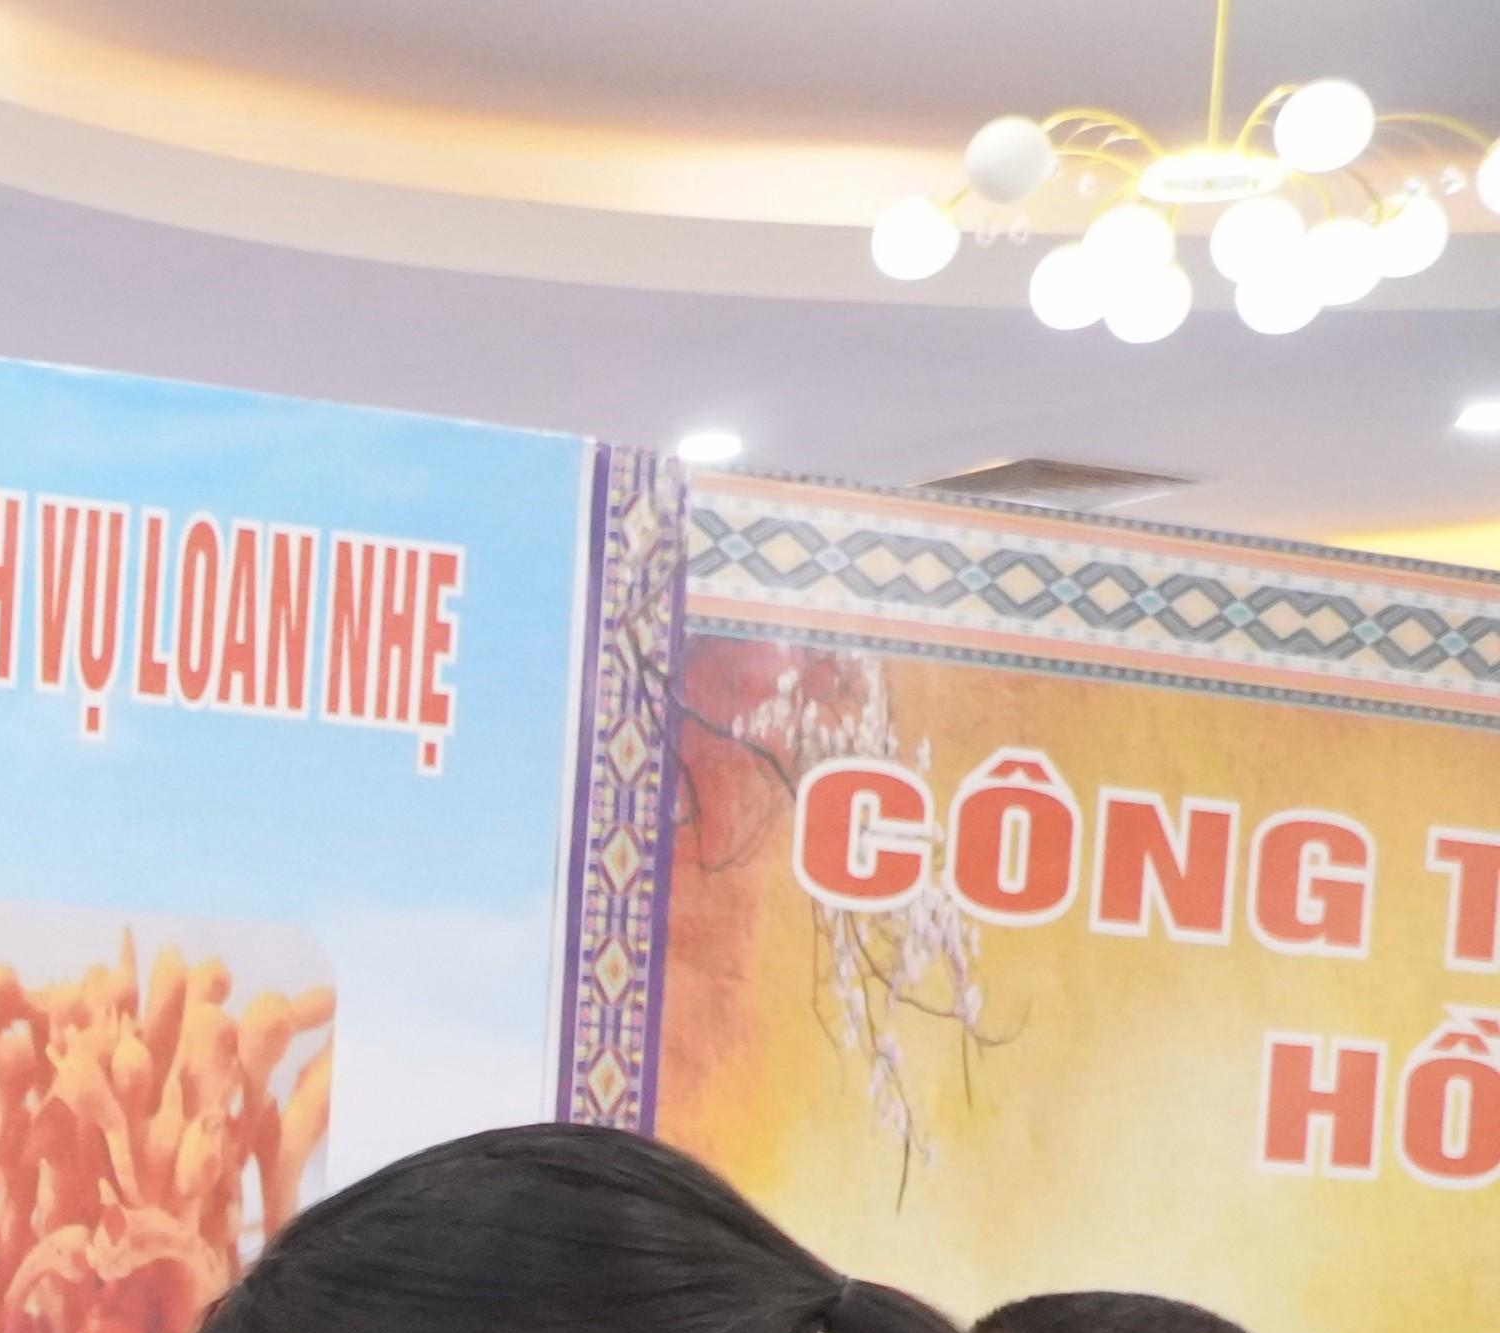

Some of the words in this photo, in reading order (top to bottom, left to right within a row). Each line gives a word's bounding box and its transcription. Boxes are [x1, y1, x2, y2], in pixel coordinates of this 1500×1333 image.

[40, 503, 123, 735] VỤ
[136, 515, 314, 711] LOAN
[325, 539, 460, 768] NHẸ
[798, 756, 1371, 953] CÔNG
